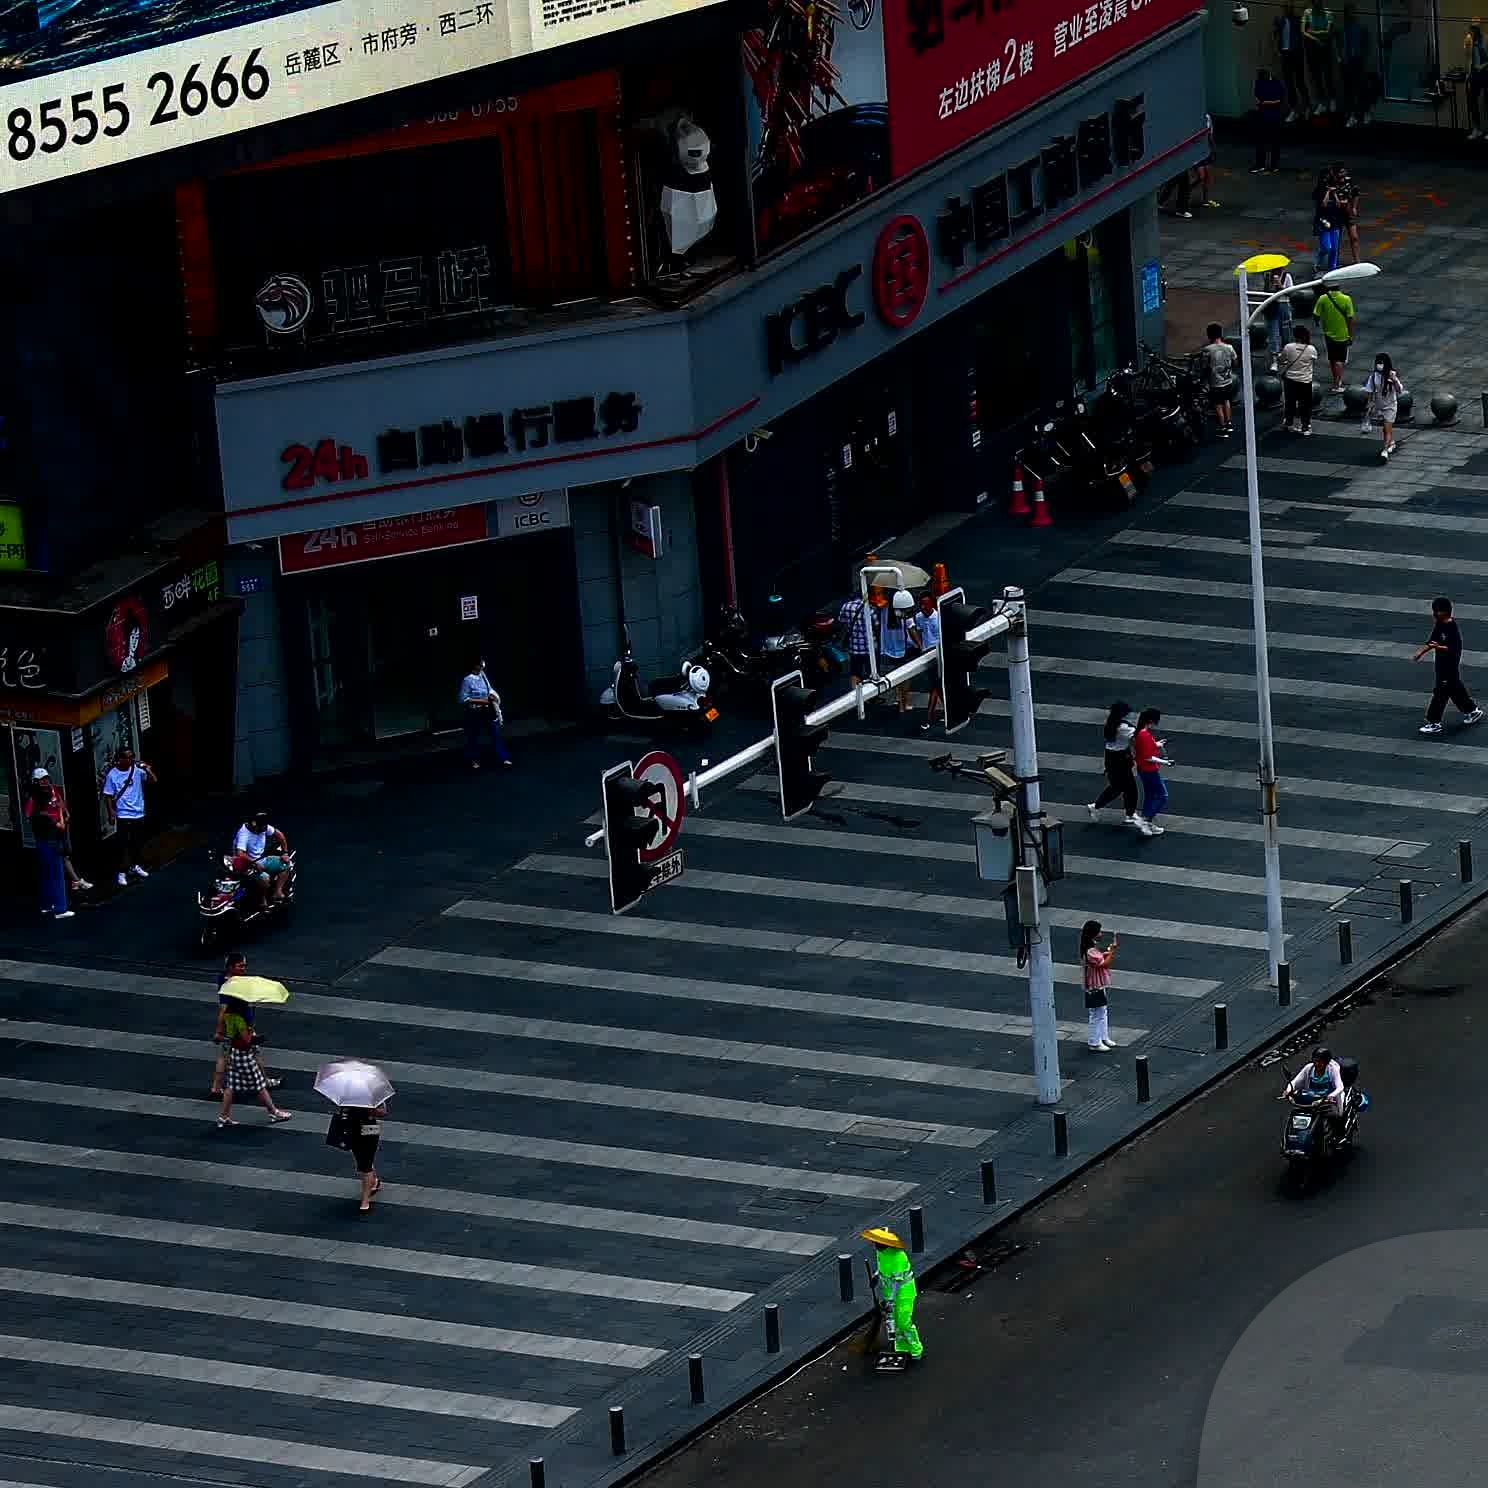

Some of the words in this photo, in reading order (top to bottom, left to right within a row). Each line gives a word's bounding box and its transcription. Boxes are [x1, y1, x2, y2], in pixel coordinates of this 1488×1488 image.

[8, 83, 130, 161] 8555
[147, 47, 269, 126] 2666
[938, 38, 1034, 119] 左边扶梯2楼
[1054, 0, 1152, 57] 营业至凌晨
[281, 438, 368, 491] 24h
[376, 392, 642, 475] 自助银行服务
[0, 646, 47, 689] 色
